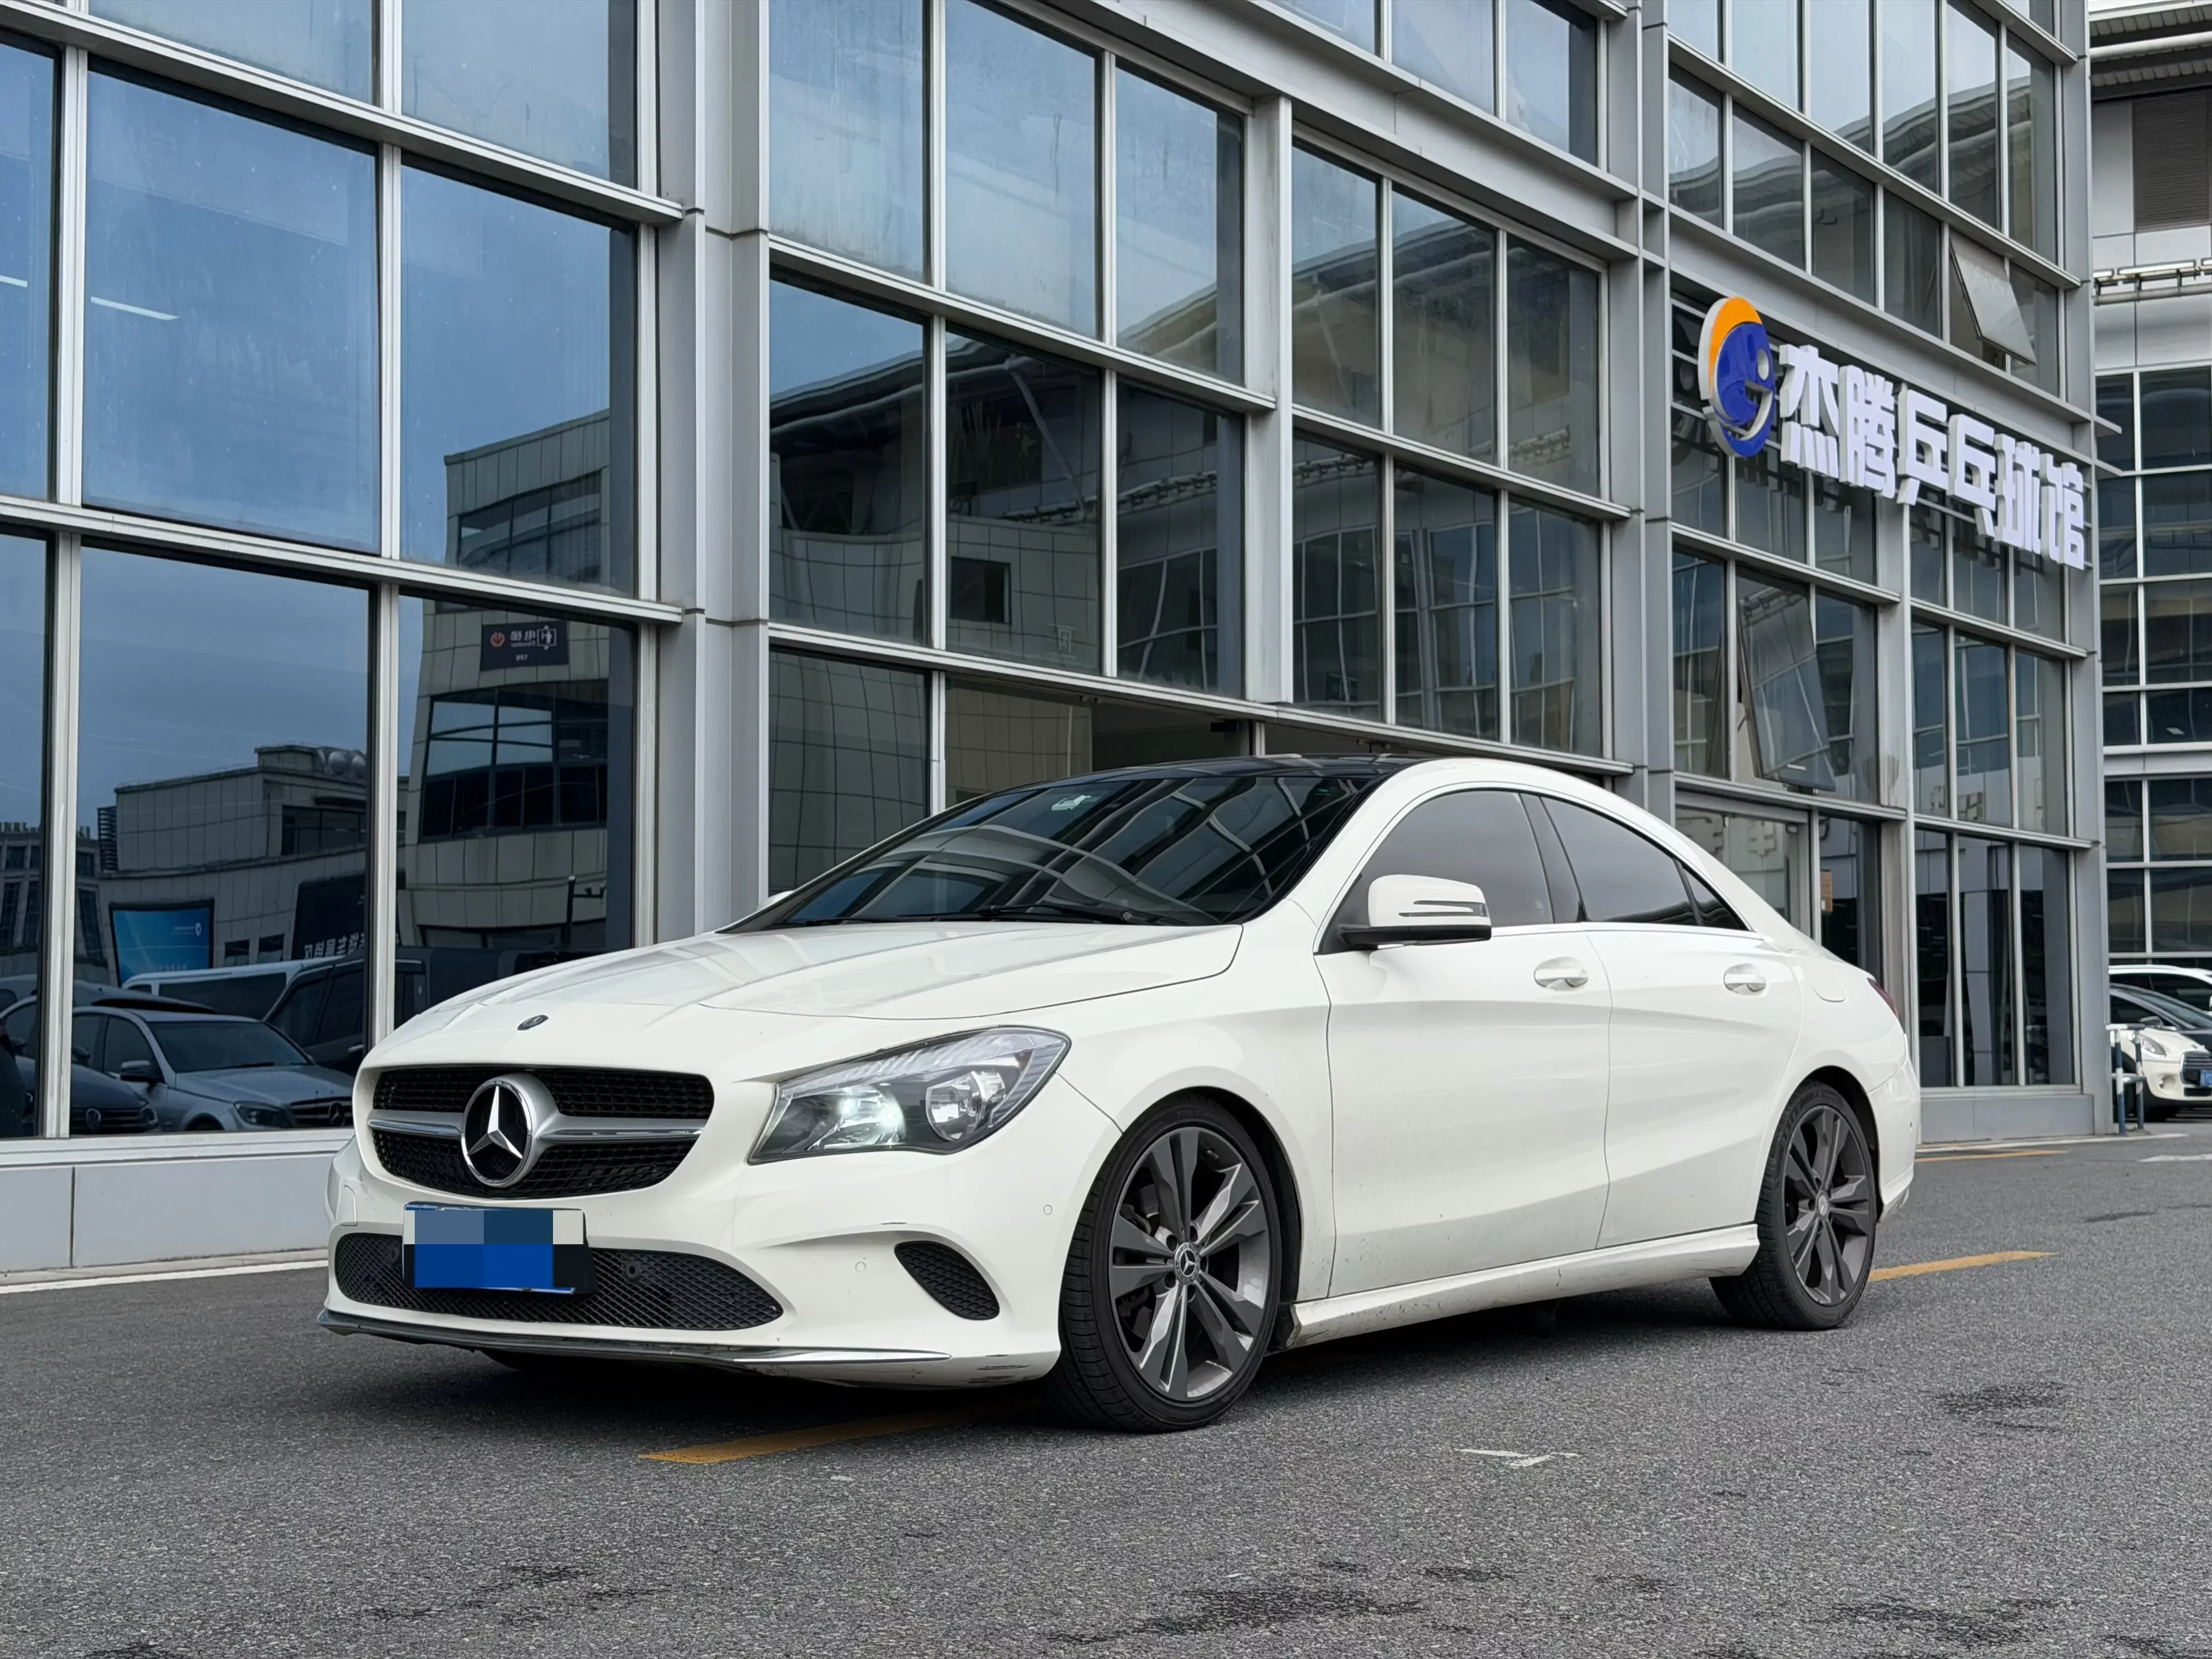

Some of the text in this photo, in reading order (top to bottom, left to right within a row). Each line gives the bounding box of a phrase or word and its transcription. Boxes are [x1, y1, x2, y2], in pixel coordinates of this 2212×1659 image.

[1779, 344, 2084, 571] 杰腾乒乓球馆
